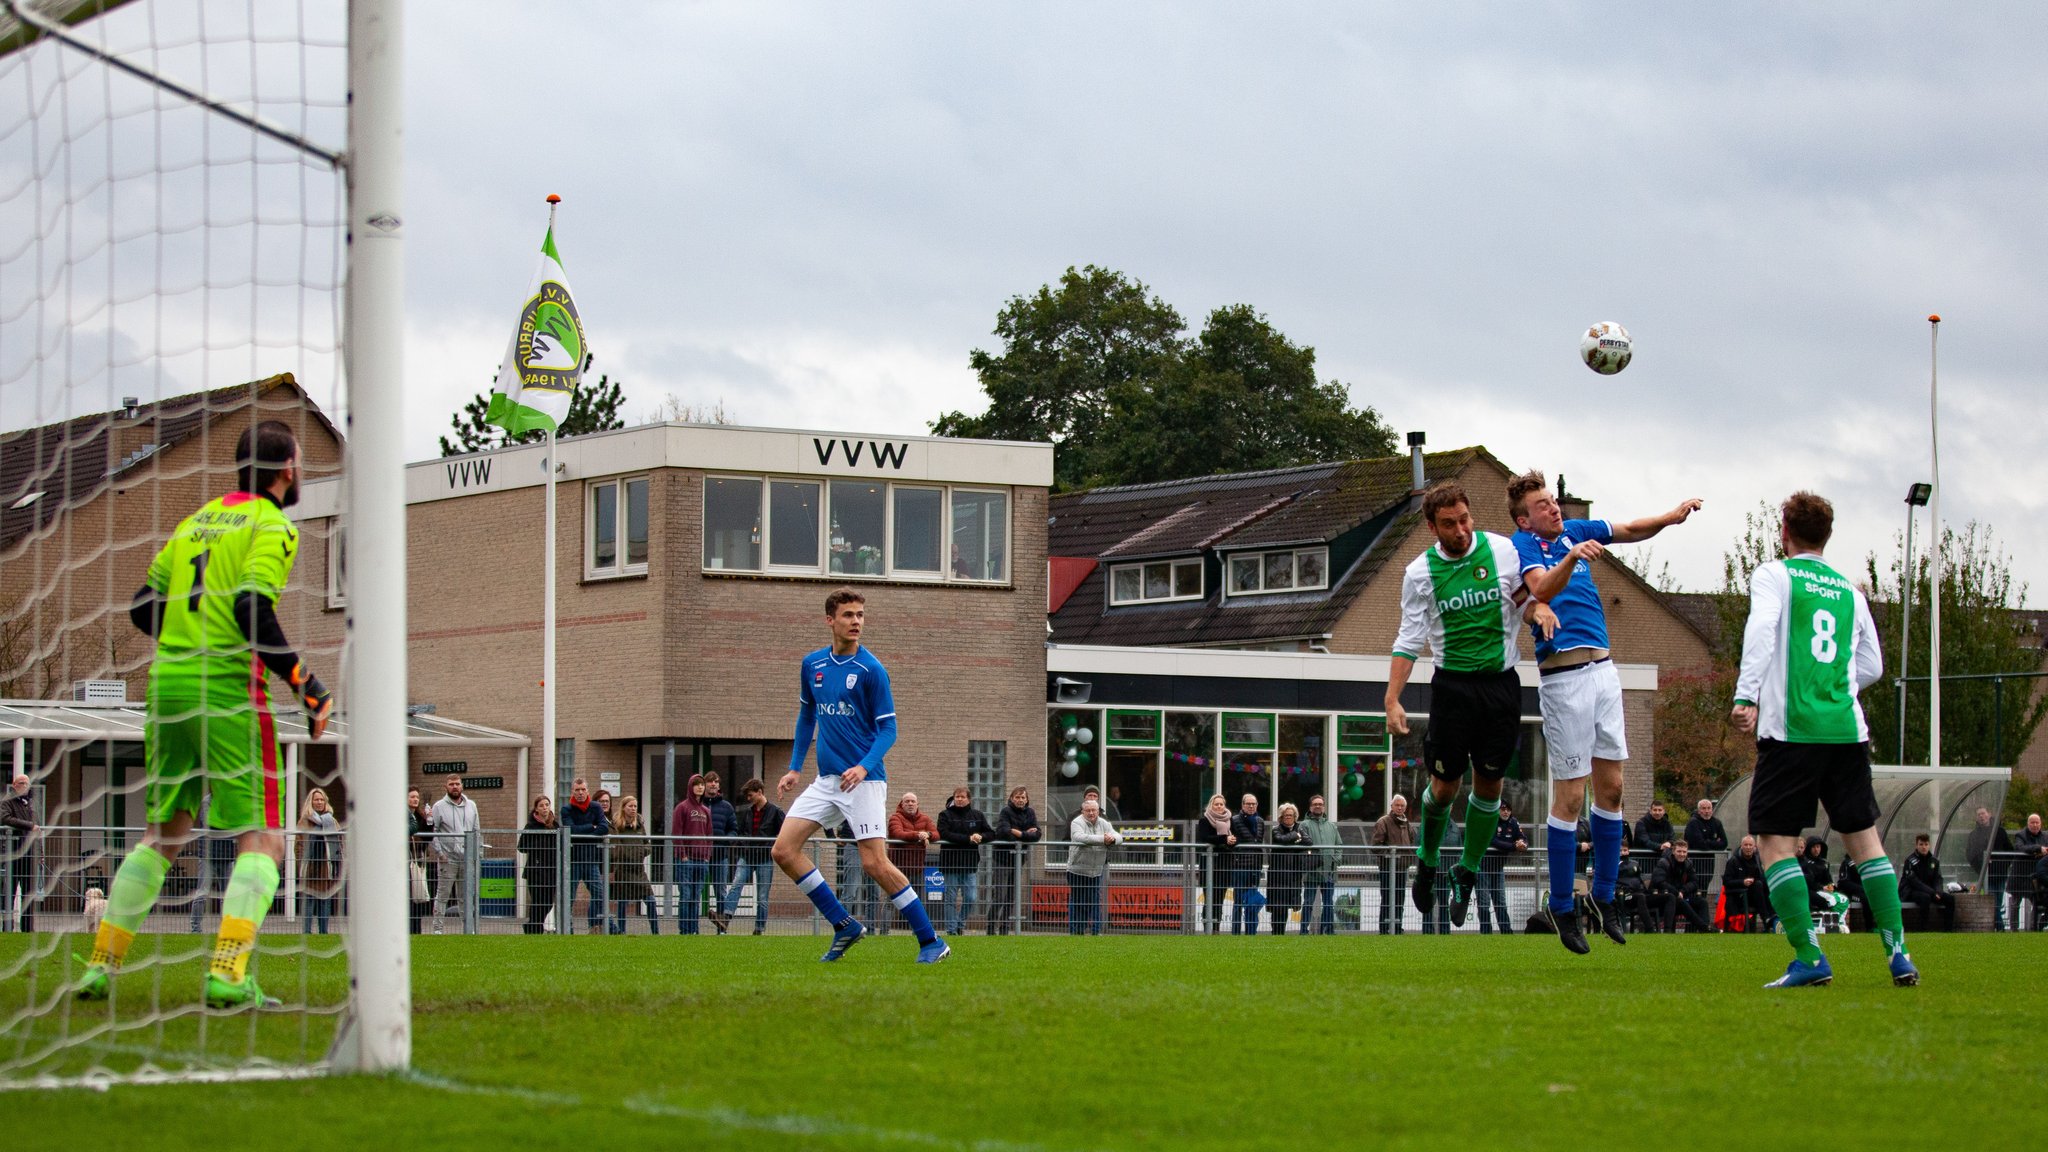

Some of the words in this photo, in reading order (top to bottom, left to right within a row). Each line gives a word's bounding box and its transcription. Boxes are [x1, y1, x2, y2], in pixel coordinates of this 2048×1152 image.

[813, 438, 909, 470] VVW
[447, 458, 492, 489] VVW
[188, 549, 211, 612] 1
[1805, 582, 1842, 601] SPORT
[1811, 608, 1837, 664] 8
[859, 823, 869, 834] 11
[1111, 894, 1149, 910] NWH
[1152, 894, 1181, 913] Jobs
